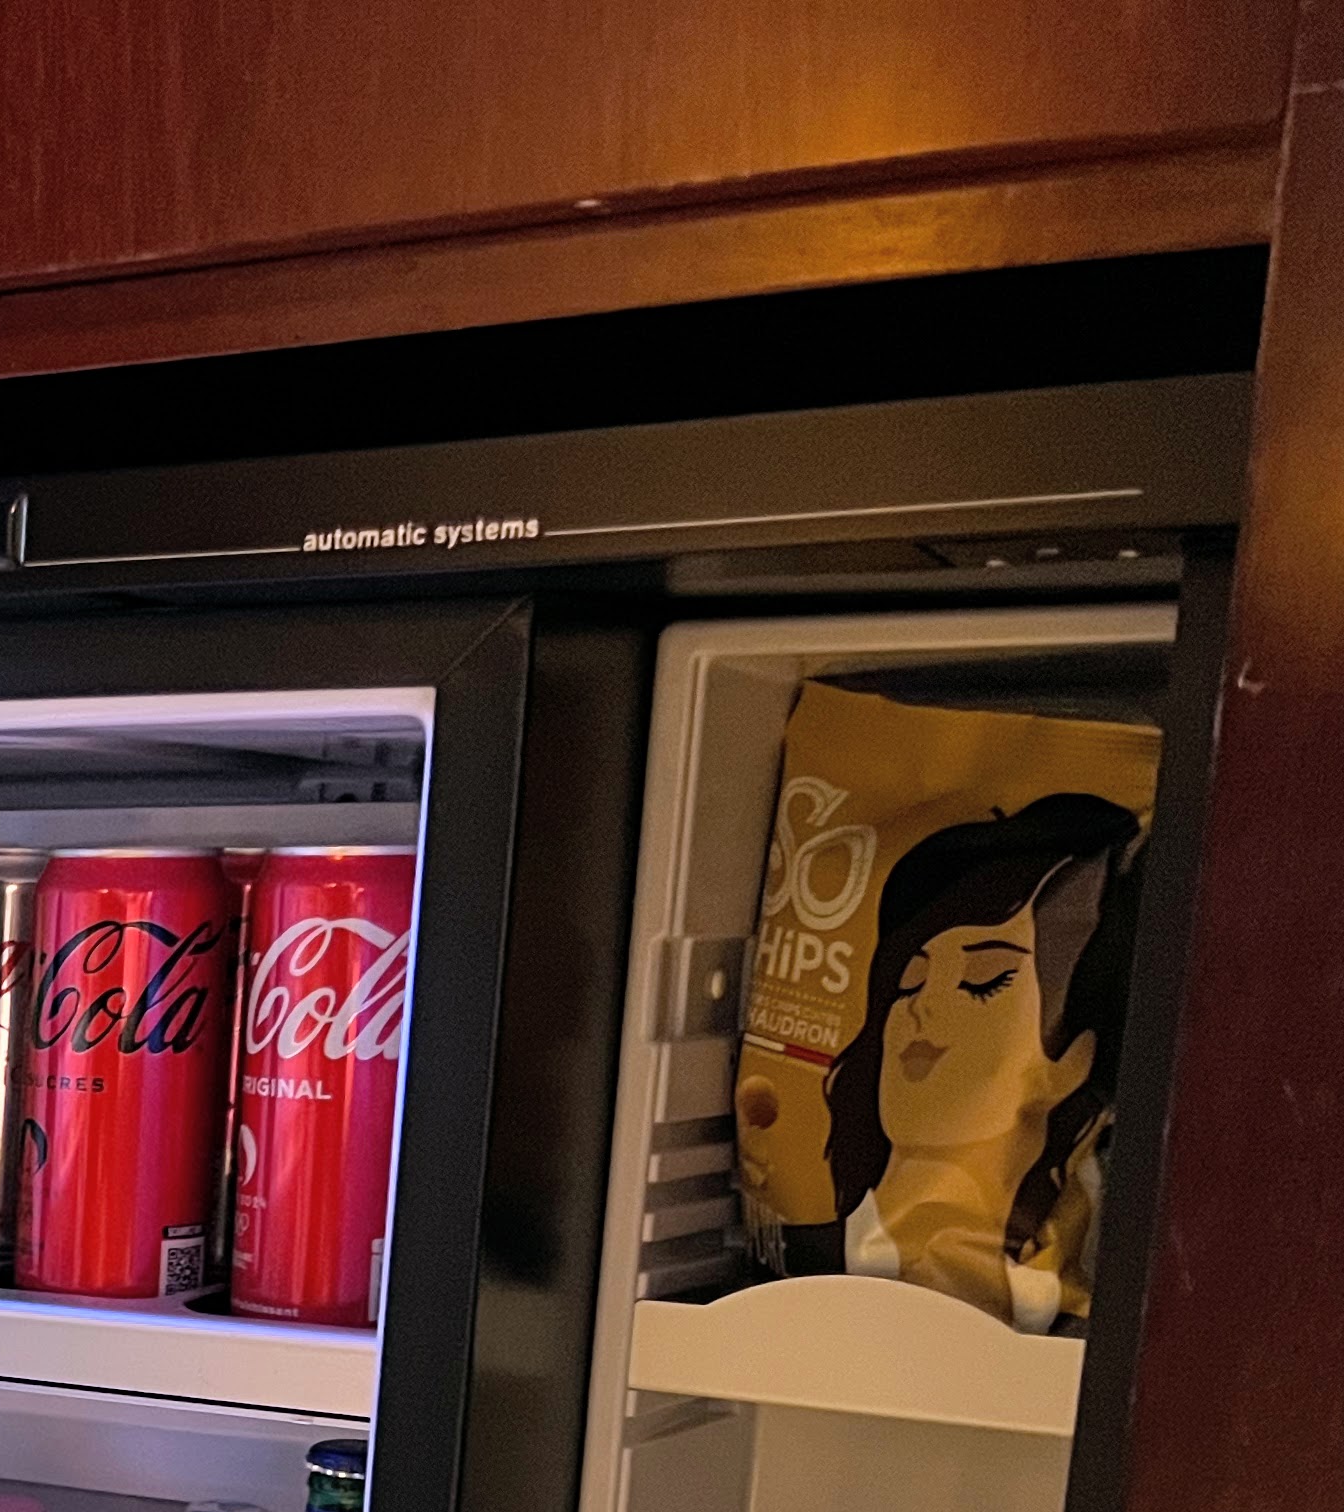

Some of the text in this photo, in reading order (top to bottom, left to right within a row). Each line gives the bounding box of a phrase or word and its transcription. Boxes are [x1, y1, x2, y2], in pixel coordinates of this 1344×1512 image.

[303, 517, 540, 551] automatic systems
[32, 920, 219, 1056] Cola
[246, 917, 410, 1061] Cola
[243, 1075, 333, 1101] RIGINAL
